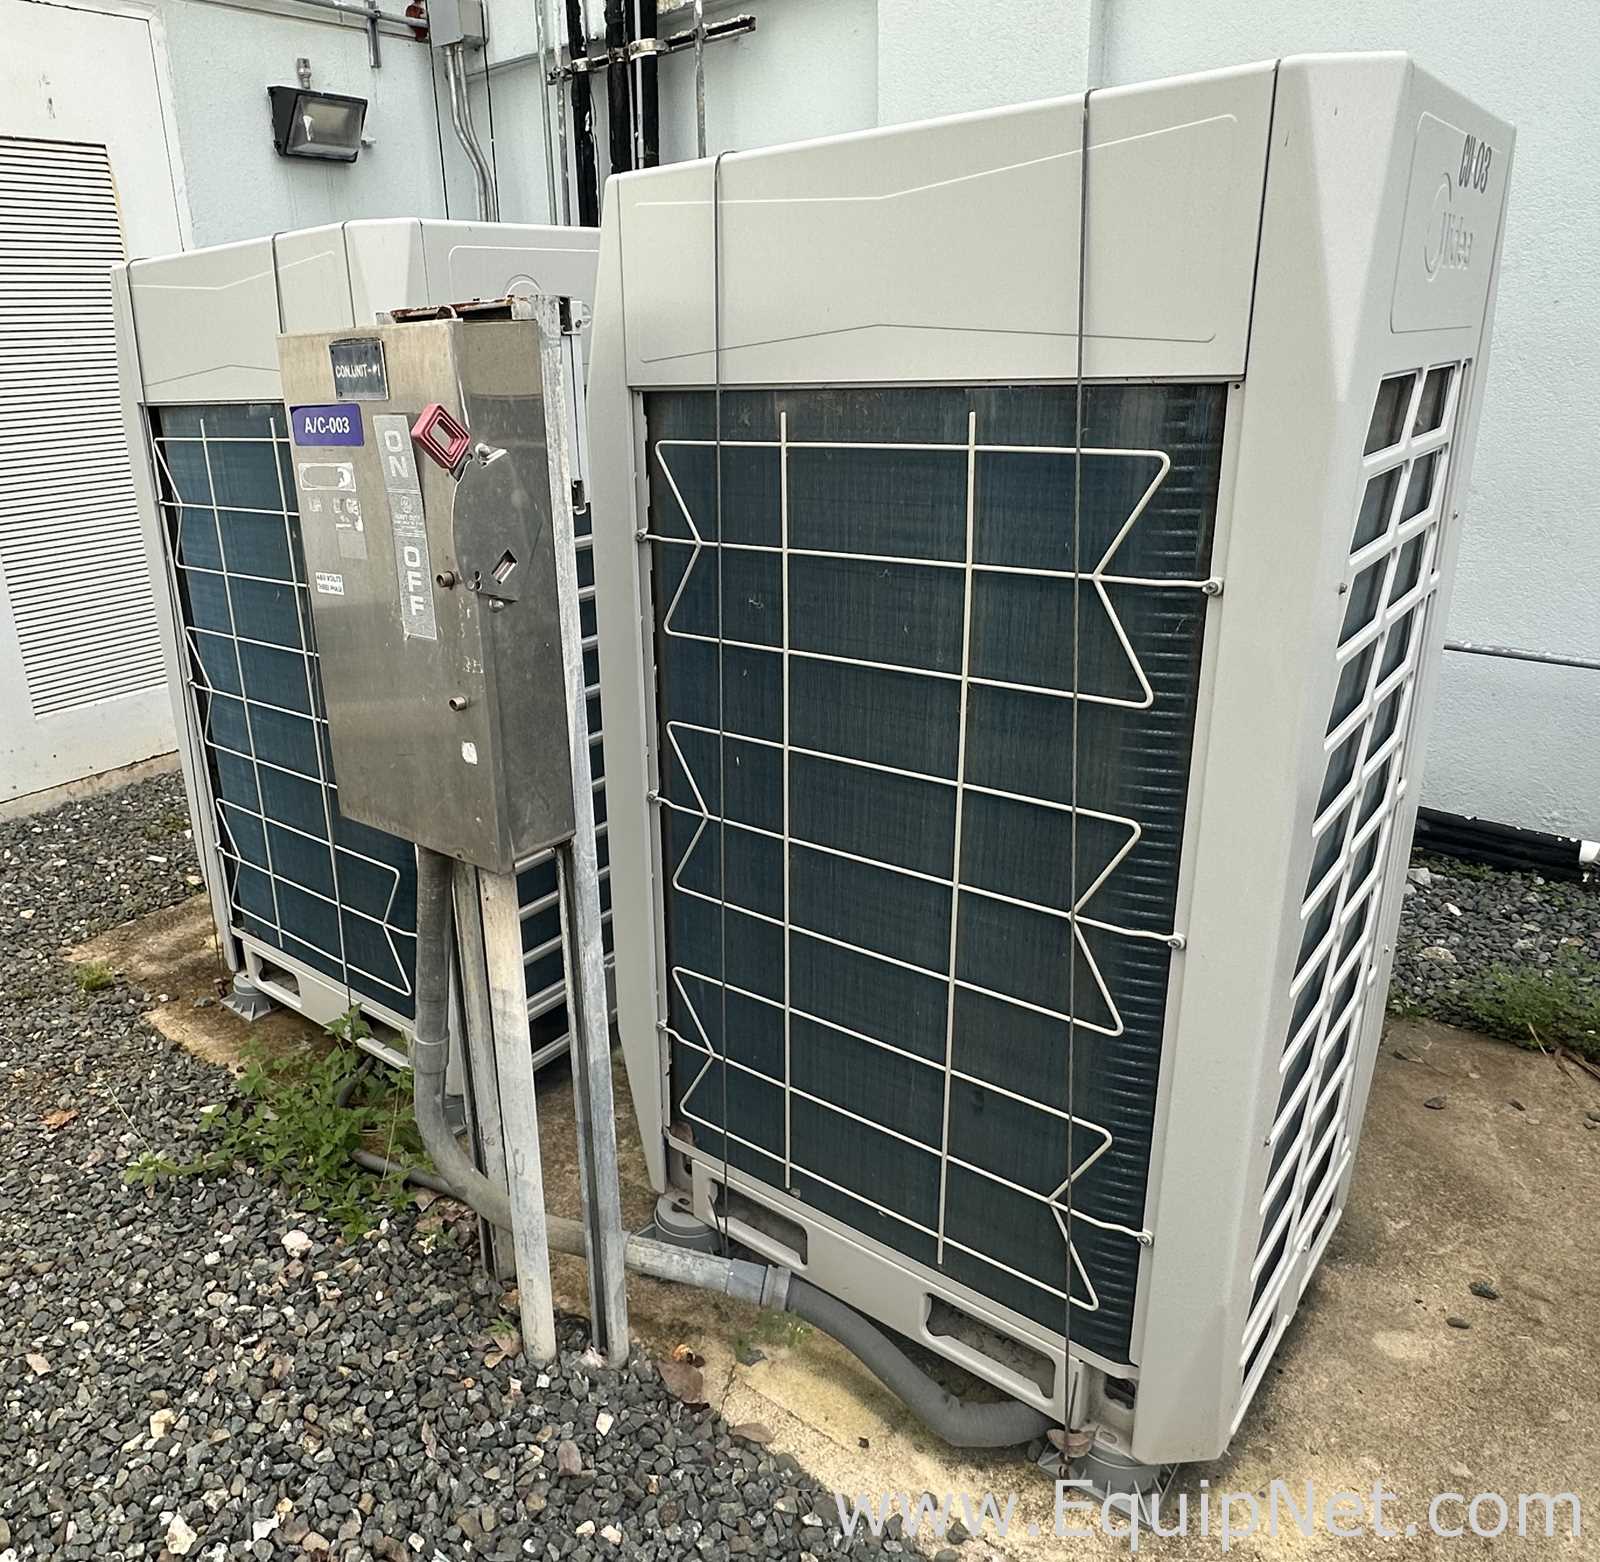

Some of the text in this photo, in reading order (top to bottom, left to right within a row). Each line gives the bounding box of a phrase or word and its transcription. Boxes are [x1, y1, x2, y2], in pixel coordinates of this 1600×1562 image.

[304, 416, 350, 434] A/C-003
[384, 430, 409, 479] ON
[403, 545, 425, 616] OFF
